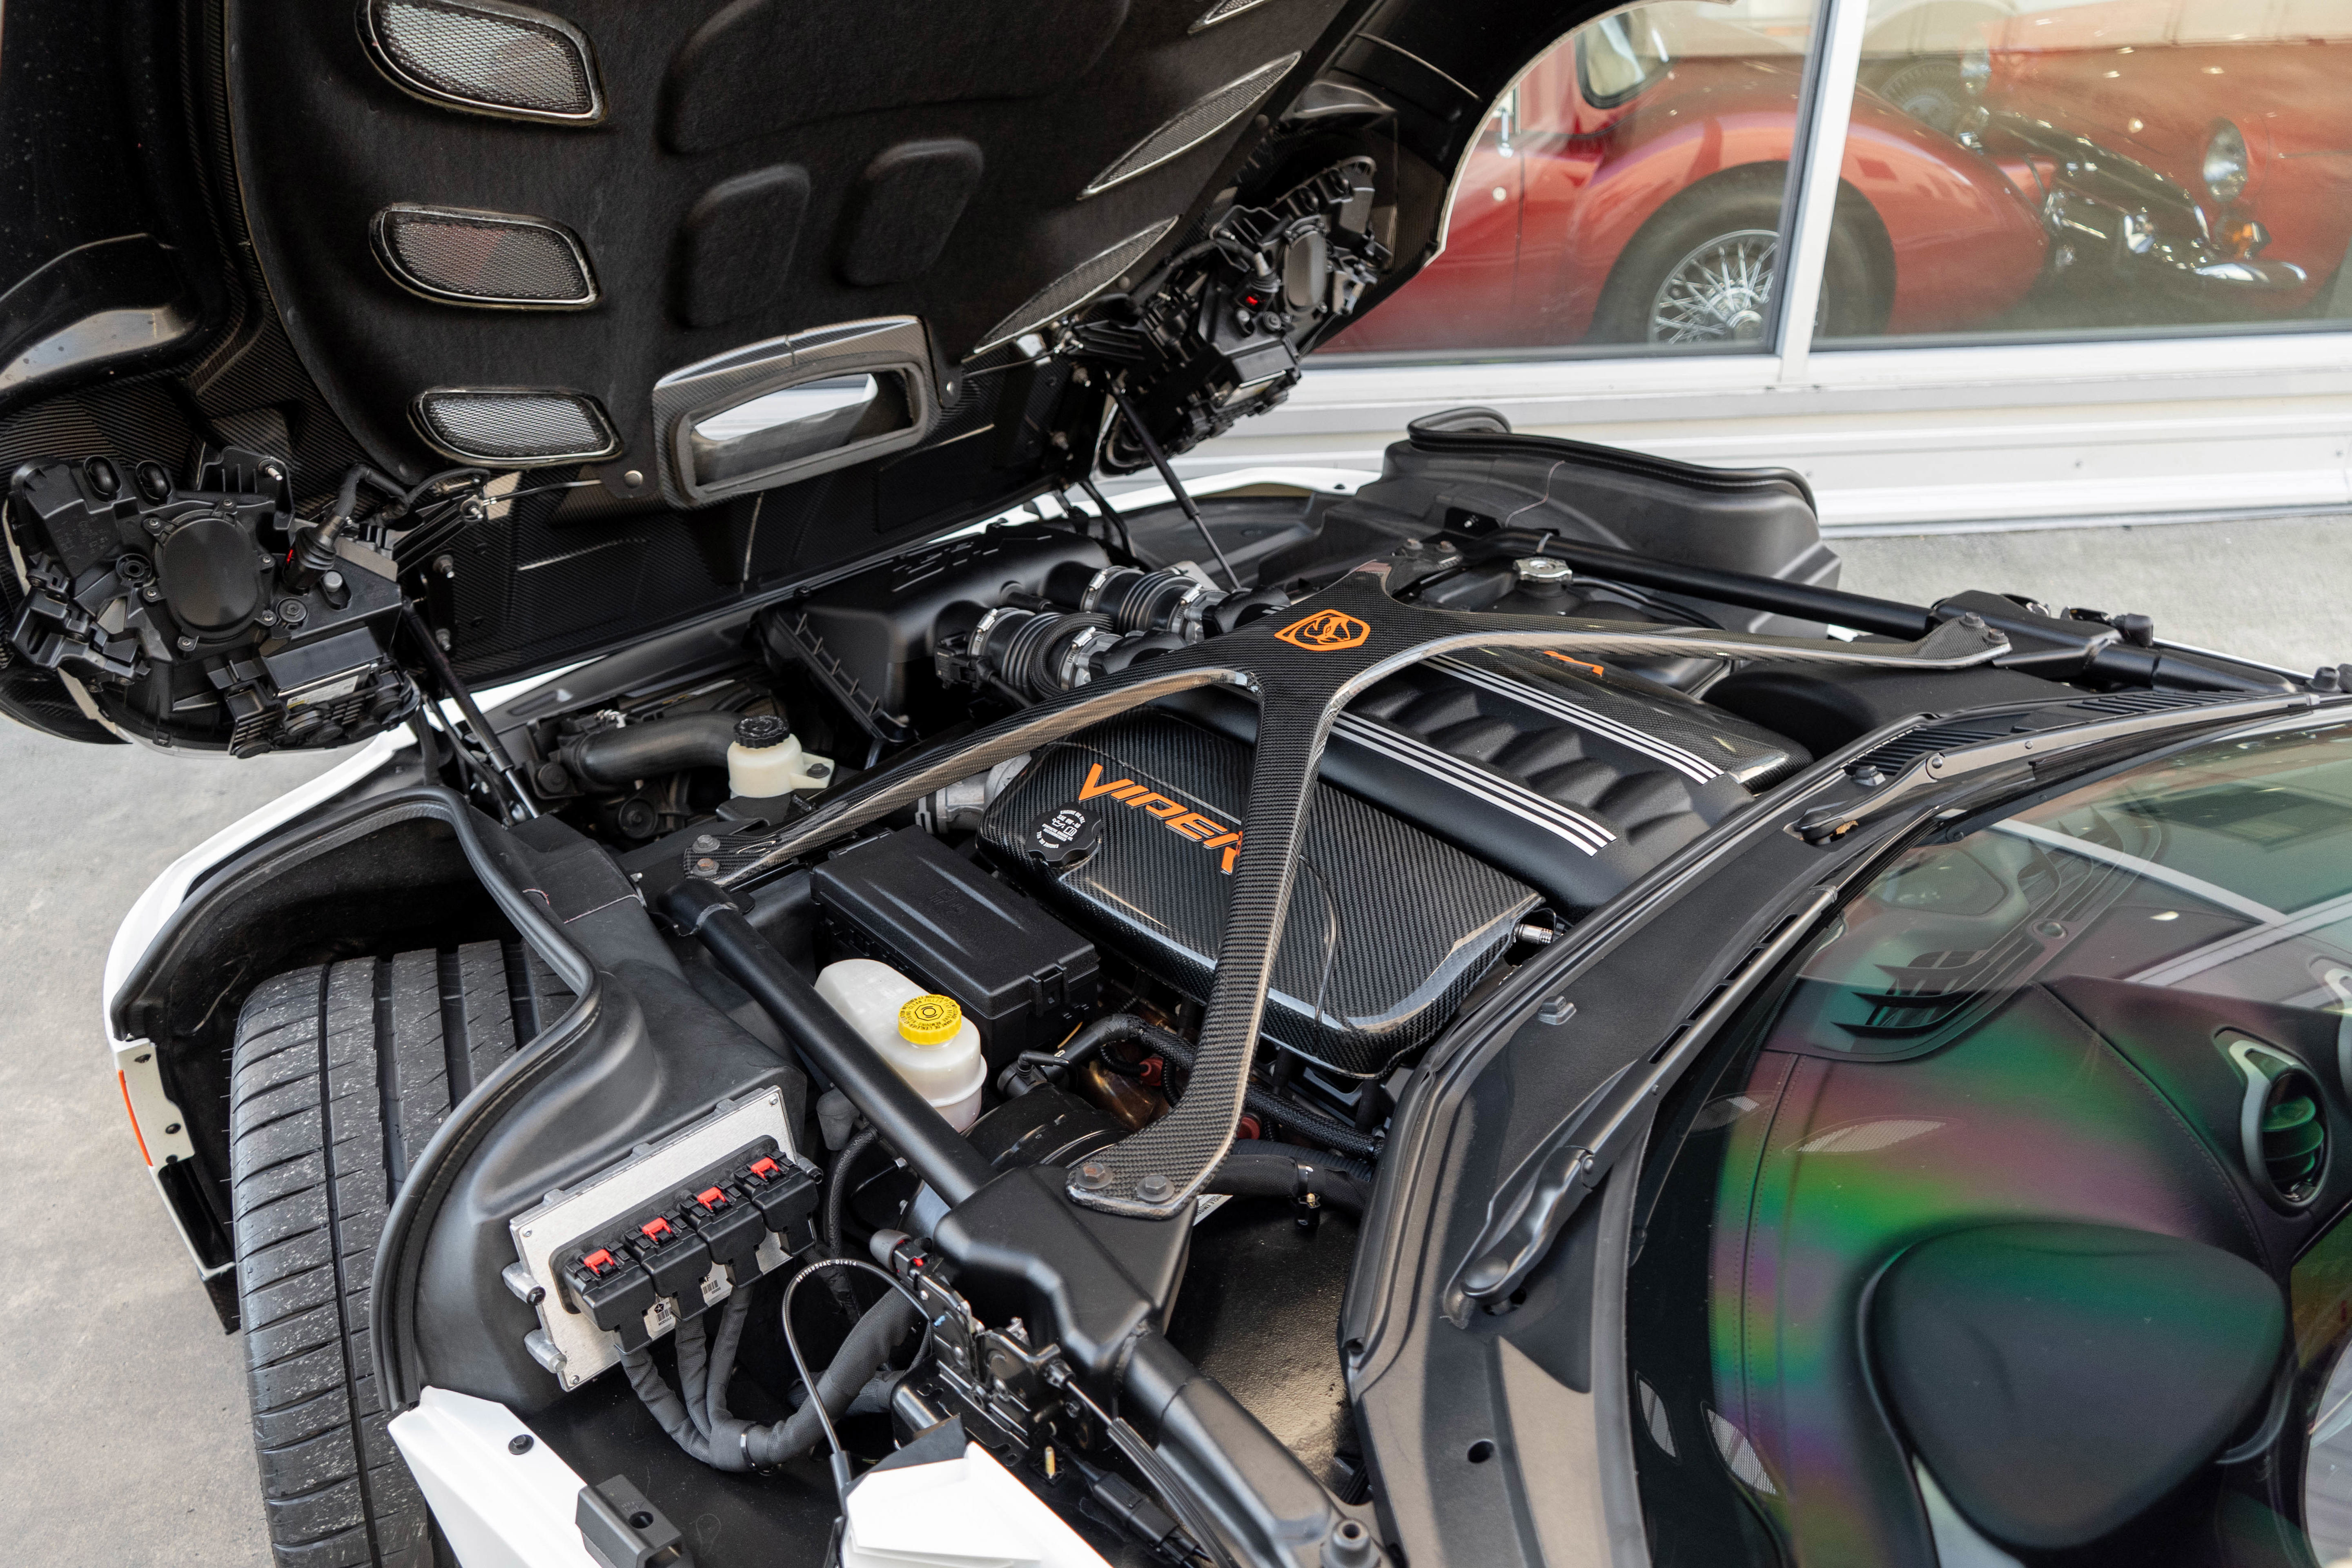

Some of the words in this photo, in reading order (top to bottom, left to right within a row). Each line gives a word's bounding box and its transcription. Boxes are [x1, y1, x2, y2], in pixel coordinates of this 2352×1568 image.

[1042, 823, 1058, 833] SYNTHETIC
[1057, 831, 1069, 839] ENGINE
[1043, 828, 1067, 842] RECOMMENDED
[658, 1316, 672, 1326] MODULE
